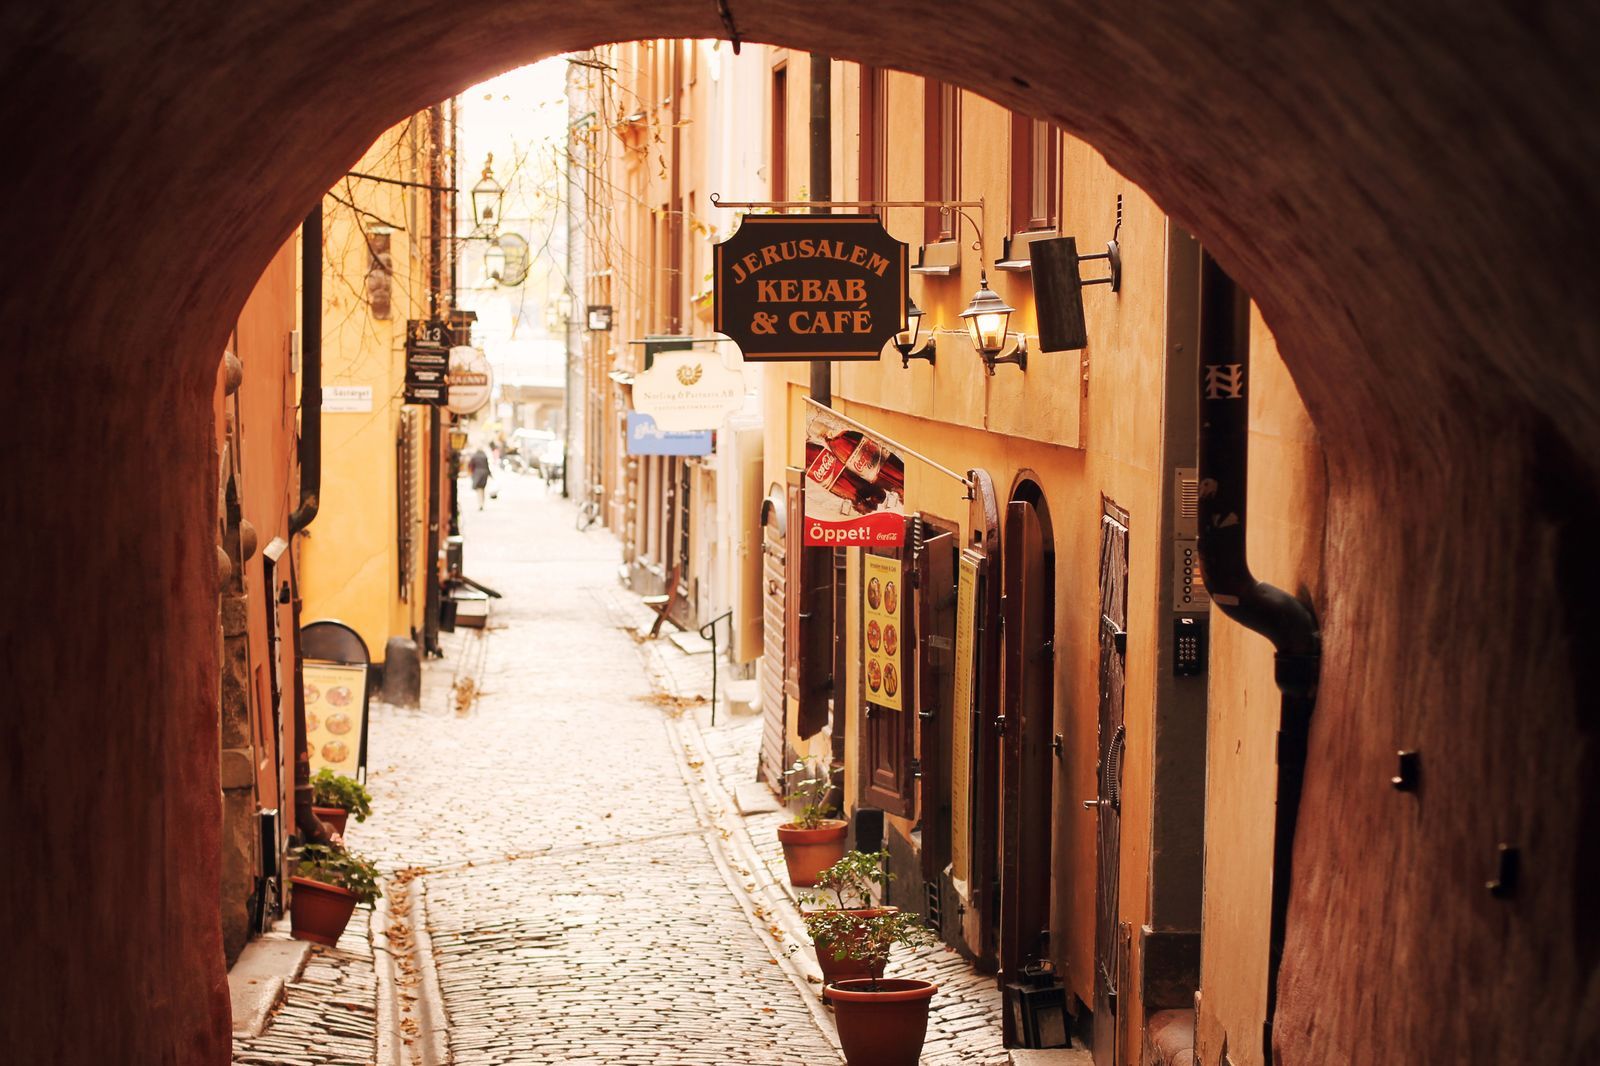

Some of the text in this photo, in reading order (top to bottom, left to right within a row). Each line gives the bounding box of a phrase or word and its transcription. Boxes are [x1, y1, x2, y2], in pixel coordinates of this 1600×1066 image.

[731, 239, 891, 285] JERUSALEM
[756, 278, 868, 303] KEBAB
[750, 302, 873, 335] & CAFÉ
[432, 327, 441, 341] 3
[809, 522, 871, 542] Öppet!
